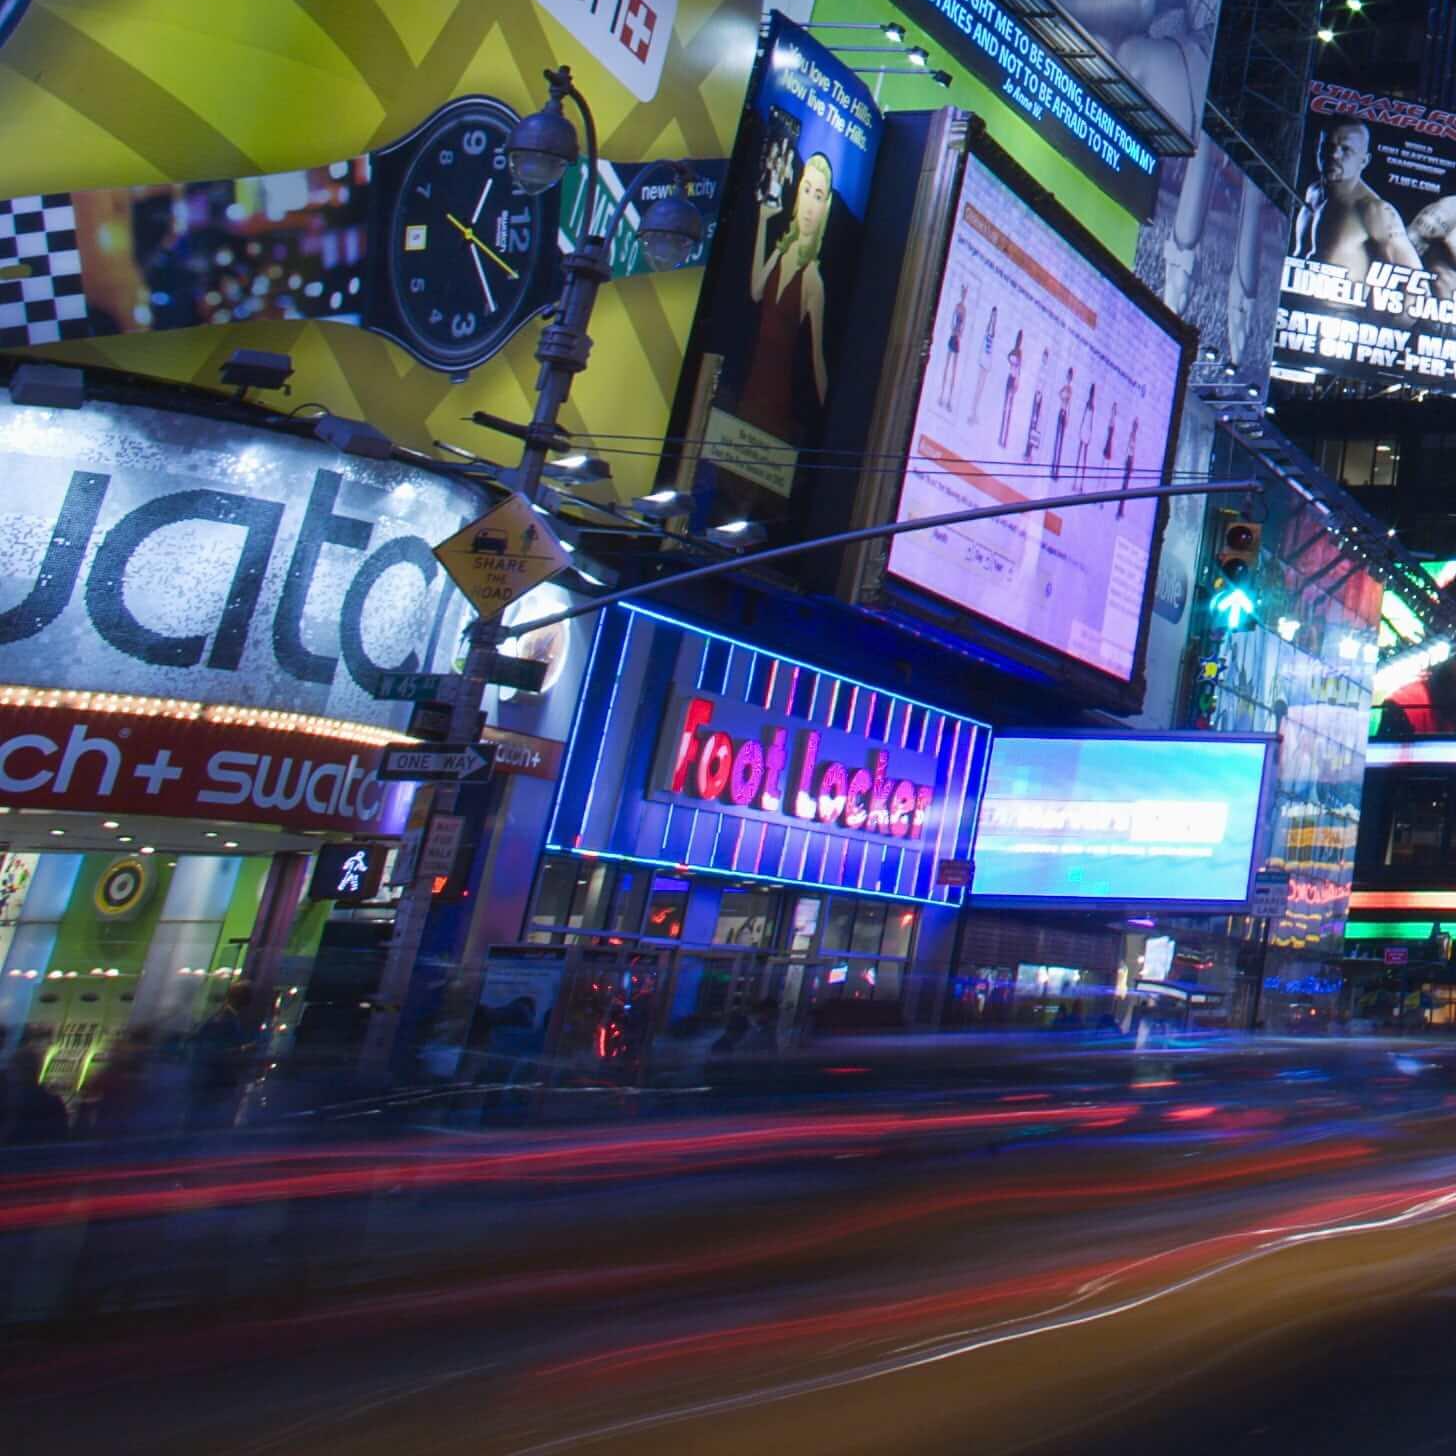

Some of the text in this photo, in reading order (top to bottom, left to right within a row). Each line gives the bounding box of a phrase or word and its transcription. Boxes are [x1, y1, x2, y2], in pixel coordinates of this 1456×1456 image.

[809, 61, 830, 92] love
[832, 80, 850, 109] The
[973, 24, 999, 57] AND
[998, 47, 1024, 76] NOT
[1023, 67, 1040, 94] TO
[1039, 80, 1054, 107] BE
[1052, 96, 1088, 142] AFRAID
[1086, 124, 1101, 152] TO
[1102, 139, 1122, 172] TRY.
[996, 10, 1012, 39] ME
[1012, 26, 1030, 55] TO
[1029, 42, 1045, 71] BE
[1043, 54, 1084, 113] STRONG,
[1084, 96, 1114, 137] LEARN
[1113, 124, 1140, 162] FROM
[1138, 147, 1157, 176] MY
[826, 103, 845, 133] The
[1366, 262, 1430, 295] UFC
[1372, 287, 1403, 313] VS
[1320, 339, 1351, 360] ON
[473, 556, 527, 574] SHARE
[487, 573, 507, 584] THE
[398, 756, 475, 771] ONE WAY
[672, 698, 936, 840] Foot Locker
